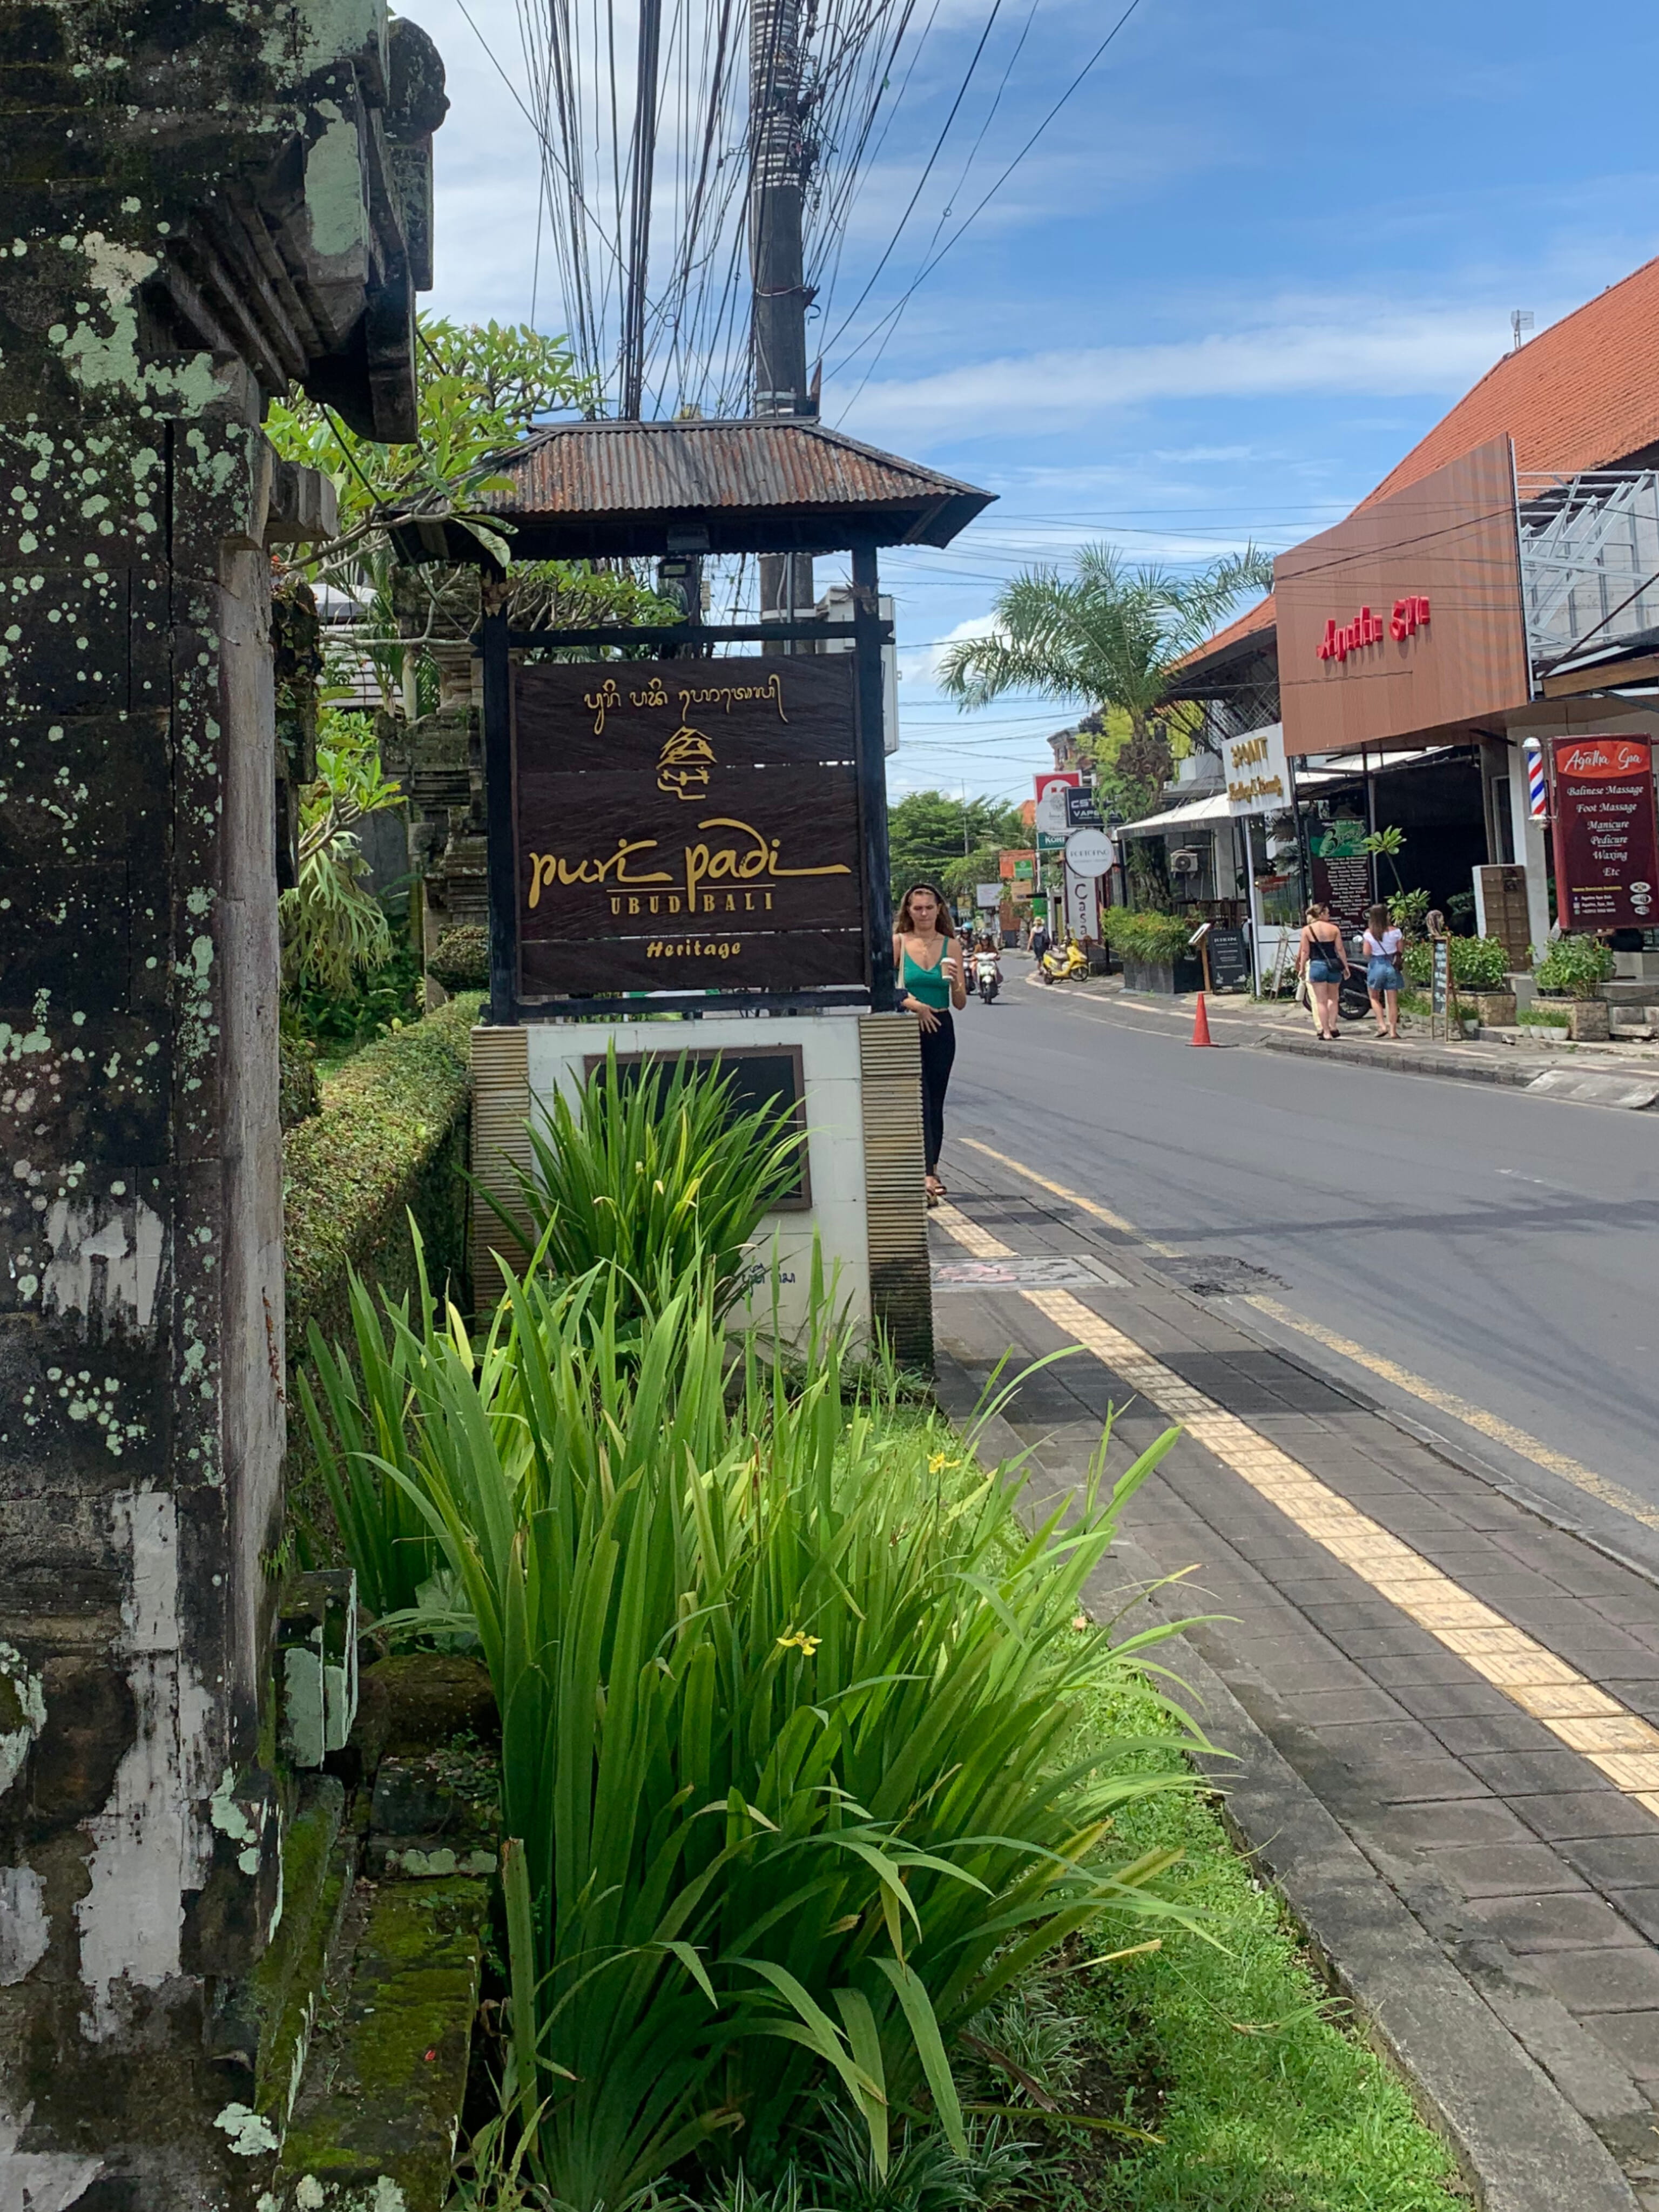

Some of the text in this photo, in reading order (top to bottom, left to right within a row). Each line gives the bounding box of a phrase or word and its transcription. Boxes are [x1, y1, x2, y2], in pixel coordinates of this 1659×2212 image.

[1563, 747, 1642, 772] Agatha Spa
[1567, 785, 1644, 797] Balinese Massage
[1576, 802, 1637, 814] Foot Massage
[1587, 819, 1630, 830] Manicure
[1590, 834, 1629, 845] Pedicure
[1593, 849, 1628, 862] Waxing
[1602, 867, 1621, 877] Etc
[611, 892, 772, 915] UBUD BALI
[1075, 883, 1088, 935] Casa
[646, 941, 741, 960] Heritage
